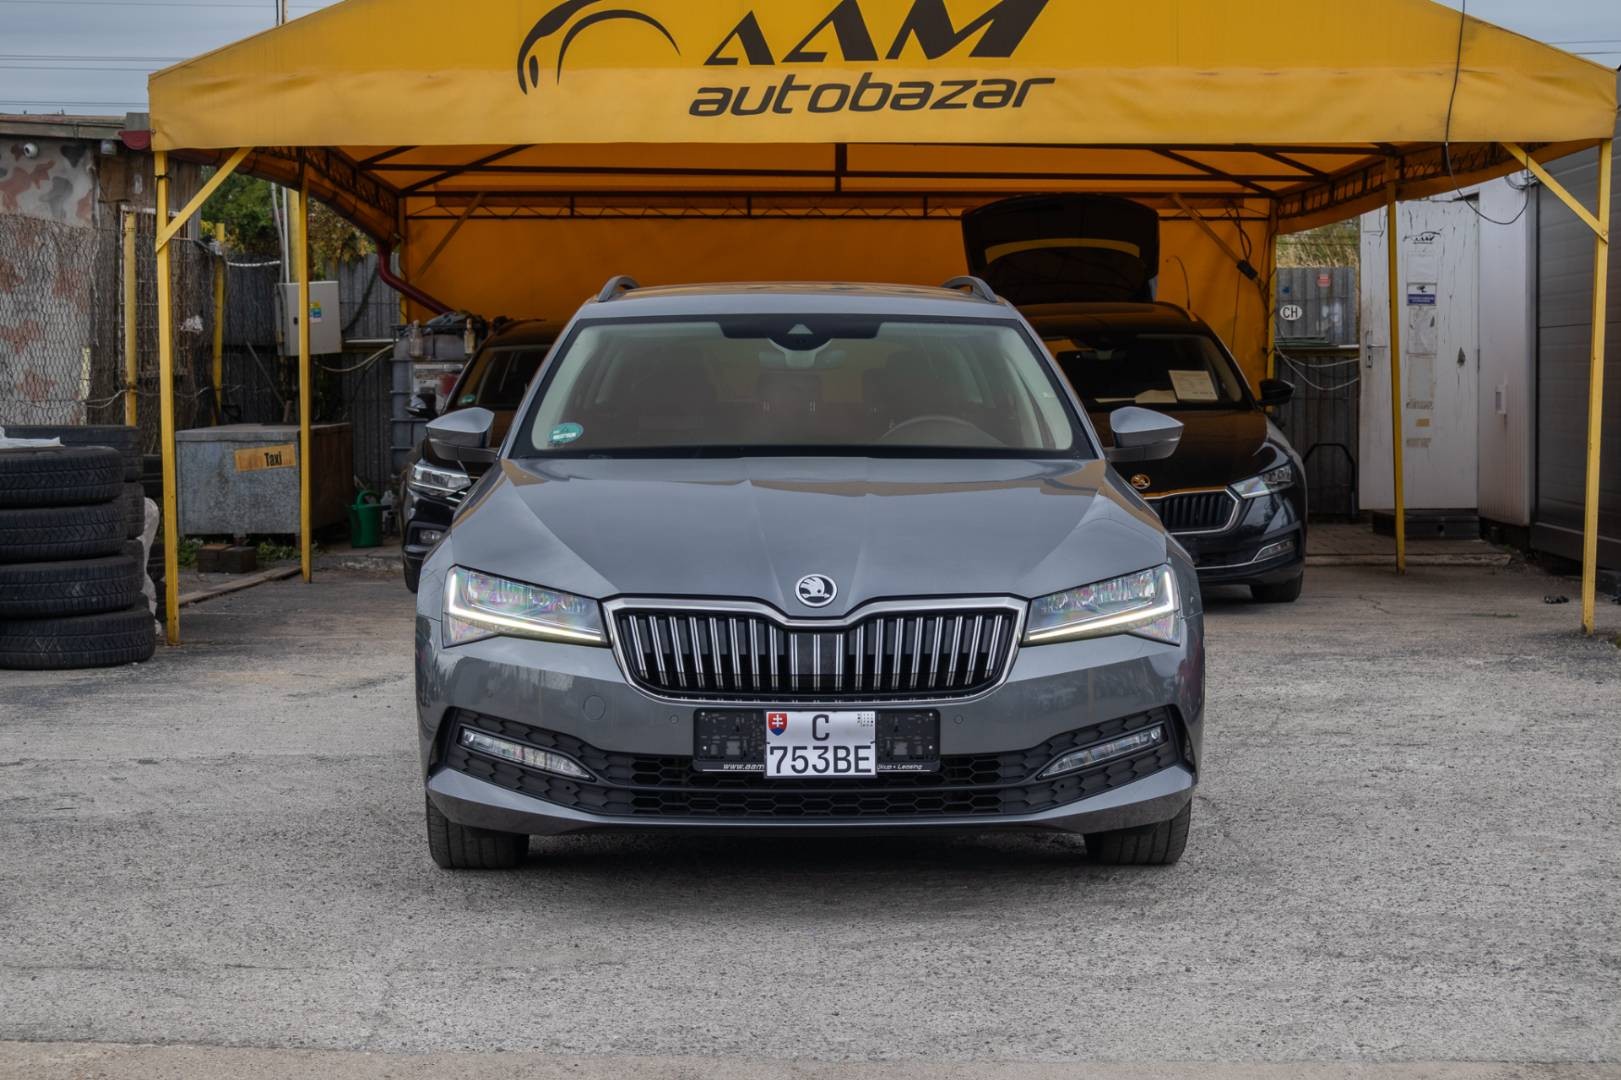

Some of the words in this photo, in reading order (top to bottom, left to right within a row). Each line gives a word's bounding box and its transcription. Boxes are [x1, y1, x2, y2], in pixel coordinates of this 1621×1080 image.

[703, 0, 1049, 65] AAM
[688, 72, 1056, 117] autobazar
[1282, 306, 1298, 319] CH
[264, 451, 282, 467] Taxi
[812, 714, 829, 741] C
[769, 745, 872, 774] 753BE
